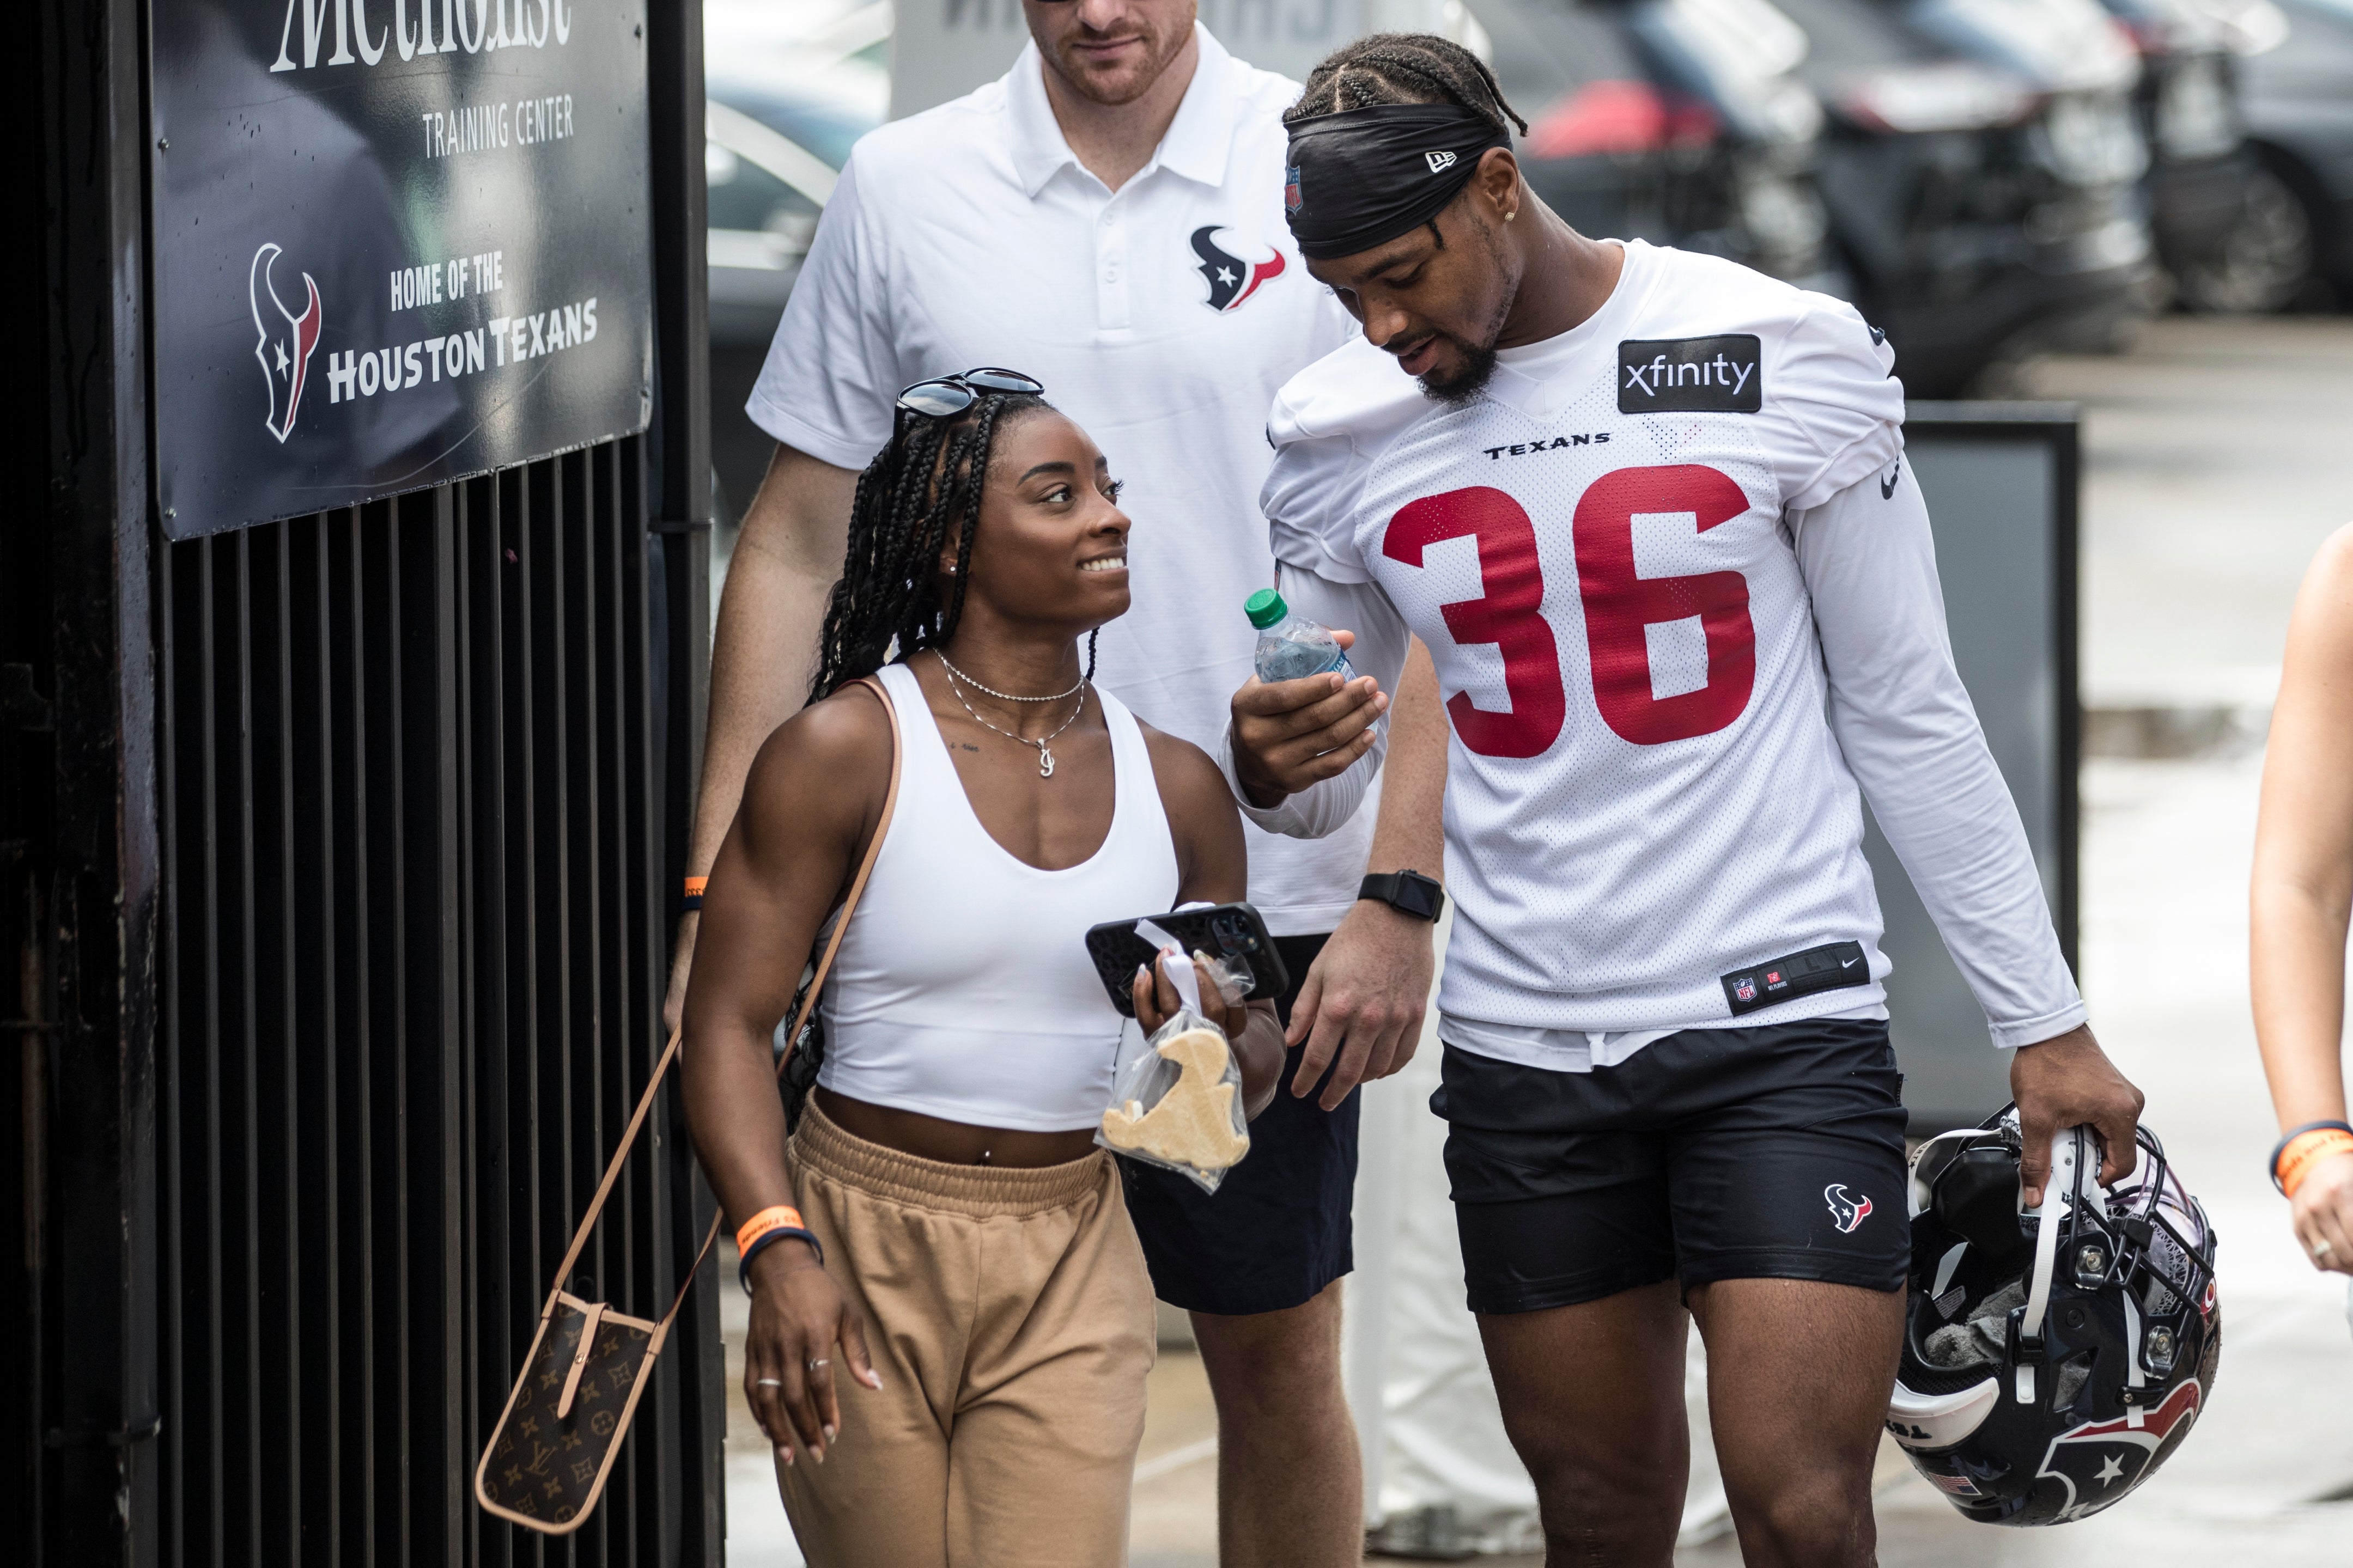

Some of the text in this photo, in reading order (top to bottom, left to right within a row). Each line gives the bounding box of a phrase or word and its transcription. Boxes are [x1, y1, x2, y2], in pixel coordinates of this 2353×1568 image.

[423, 94, 574, 158] TRAINING CENTER
[390, 251, 503, 312] HOME OF THE
[1625, 353, 1754, 397] xfinity
[1483, 432, 1611, 460] TEXANS
[1382, 463, 1756, 759] 36
[1738, 987, 1754, 998] NFL
